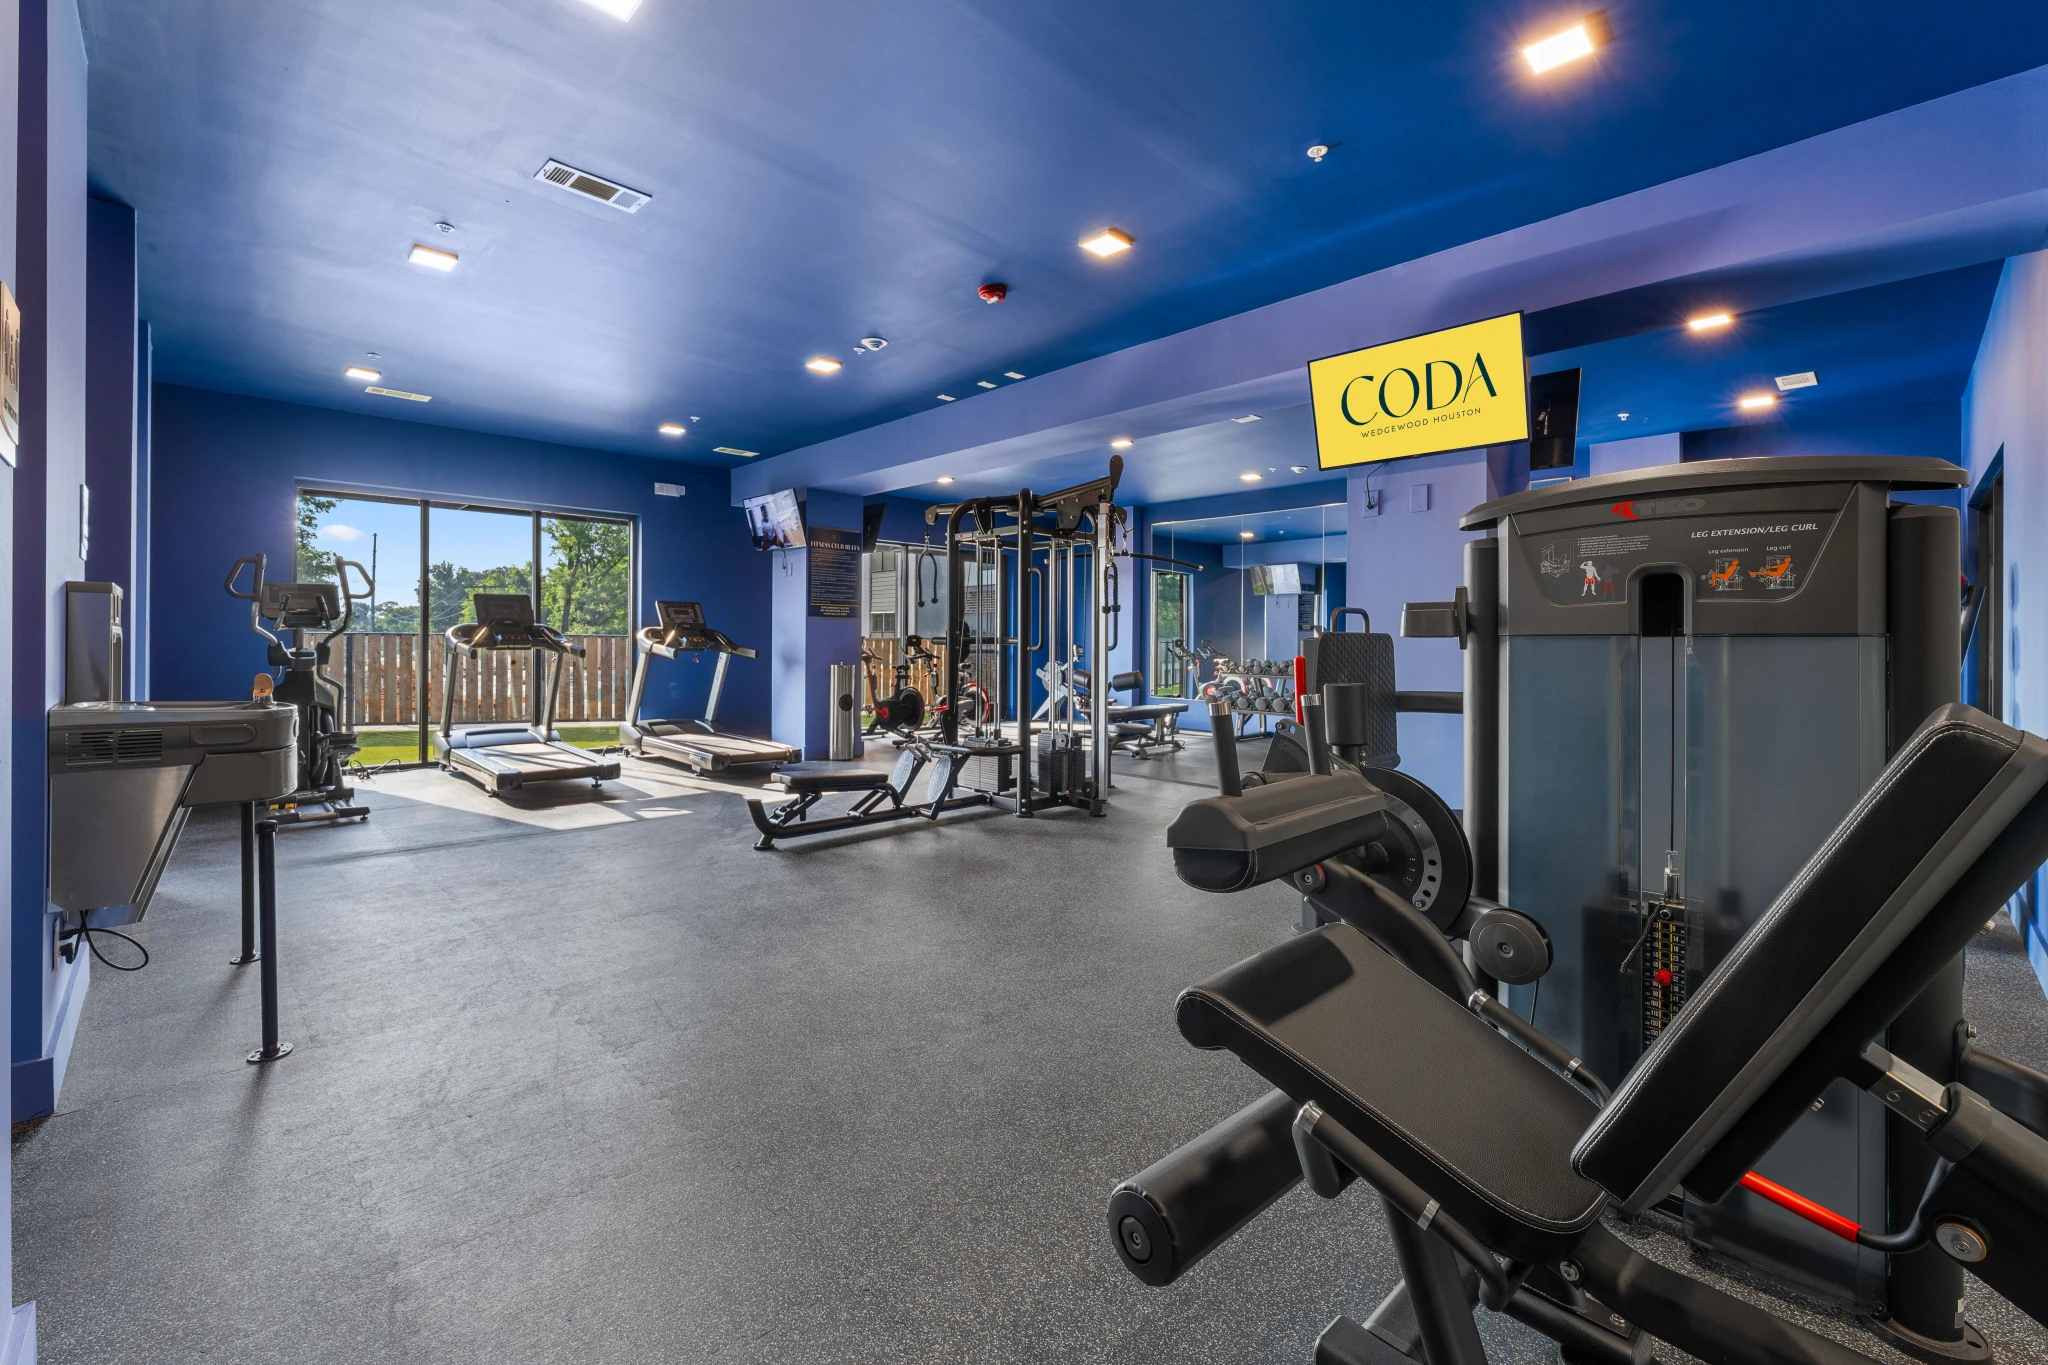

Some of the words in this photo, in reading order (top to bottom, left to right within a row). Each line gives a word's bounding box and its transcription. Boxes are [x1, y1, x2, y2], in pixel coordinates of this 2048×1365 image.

[1341, 352, 1498, 426] CODA
[1361, 418, 1428, 438] WEDGEWOOD
[1433, 407, 1481, 424] HOUSTON
[1636, 498, 1705, 516] TKO
[1691, 530, 1709, 539] LEG
[1791, 522, 1819, 532] CURL
[1720, 546, 1749, 554] extension
[1885, 1089, 1903, 1103] 6
[1918, 1109, 1938, 1124] 5
